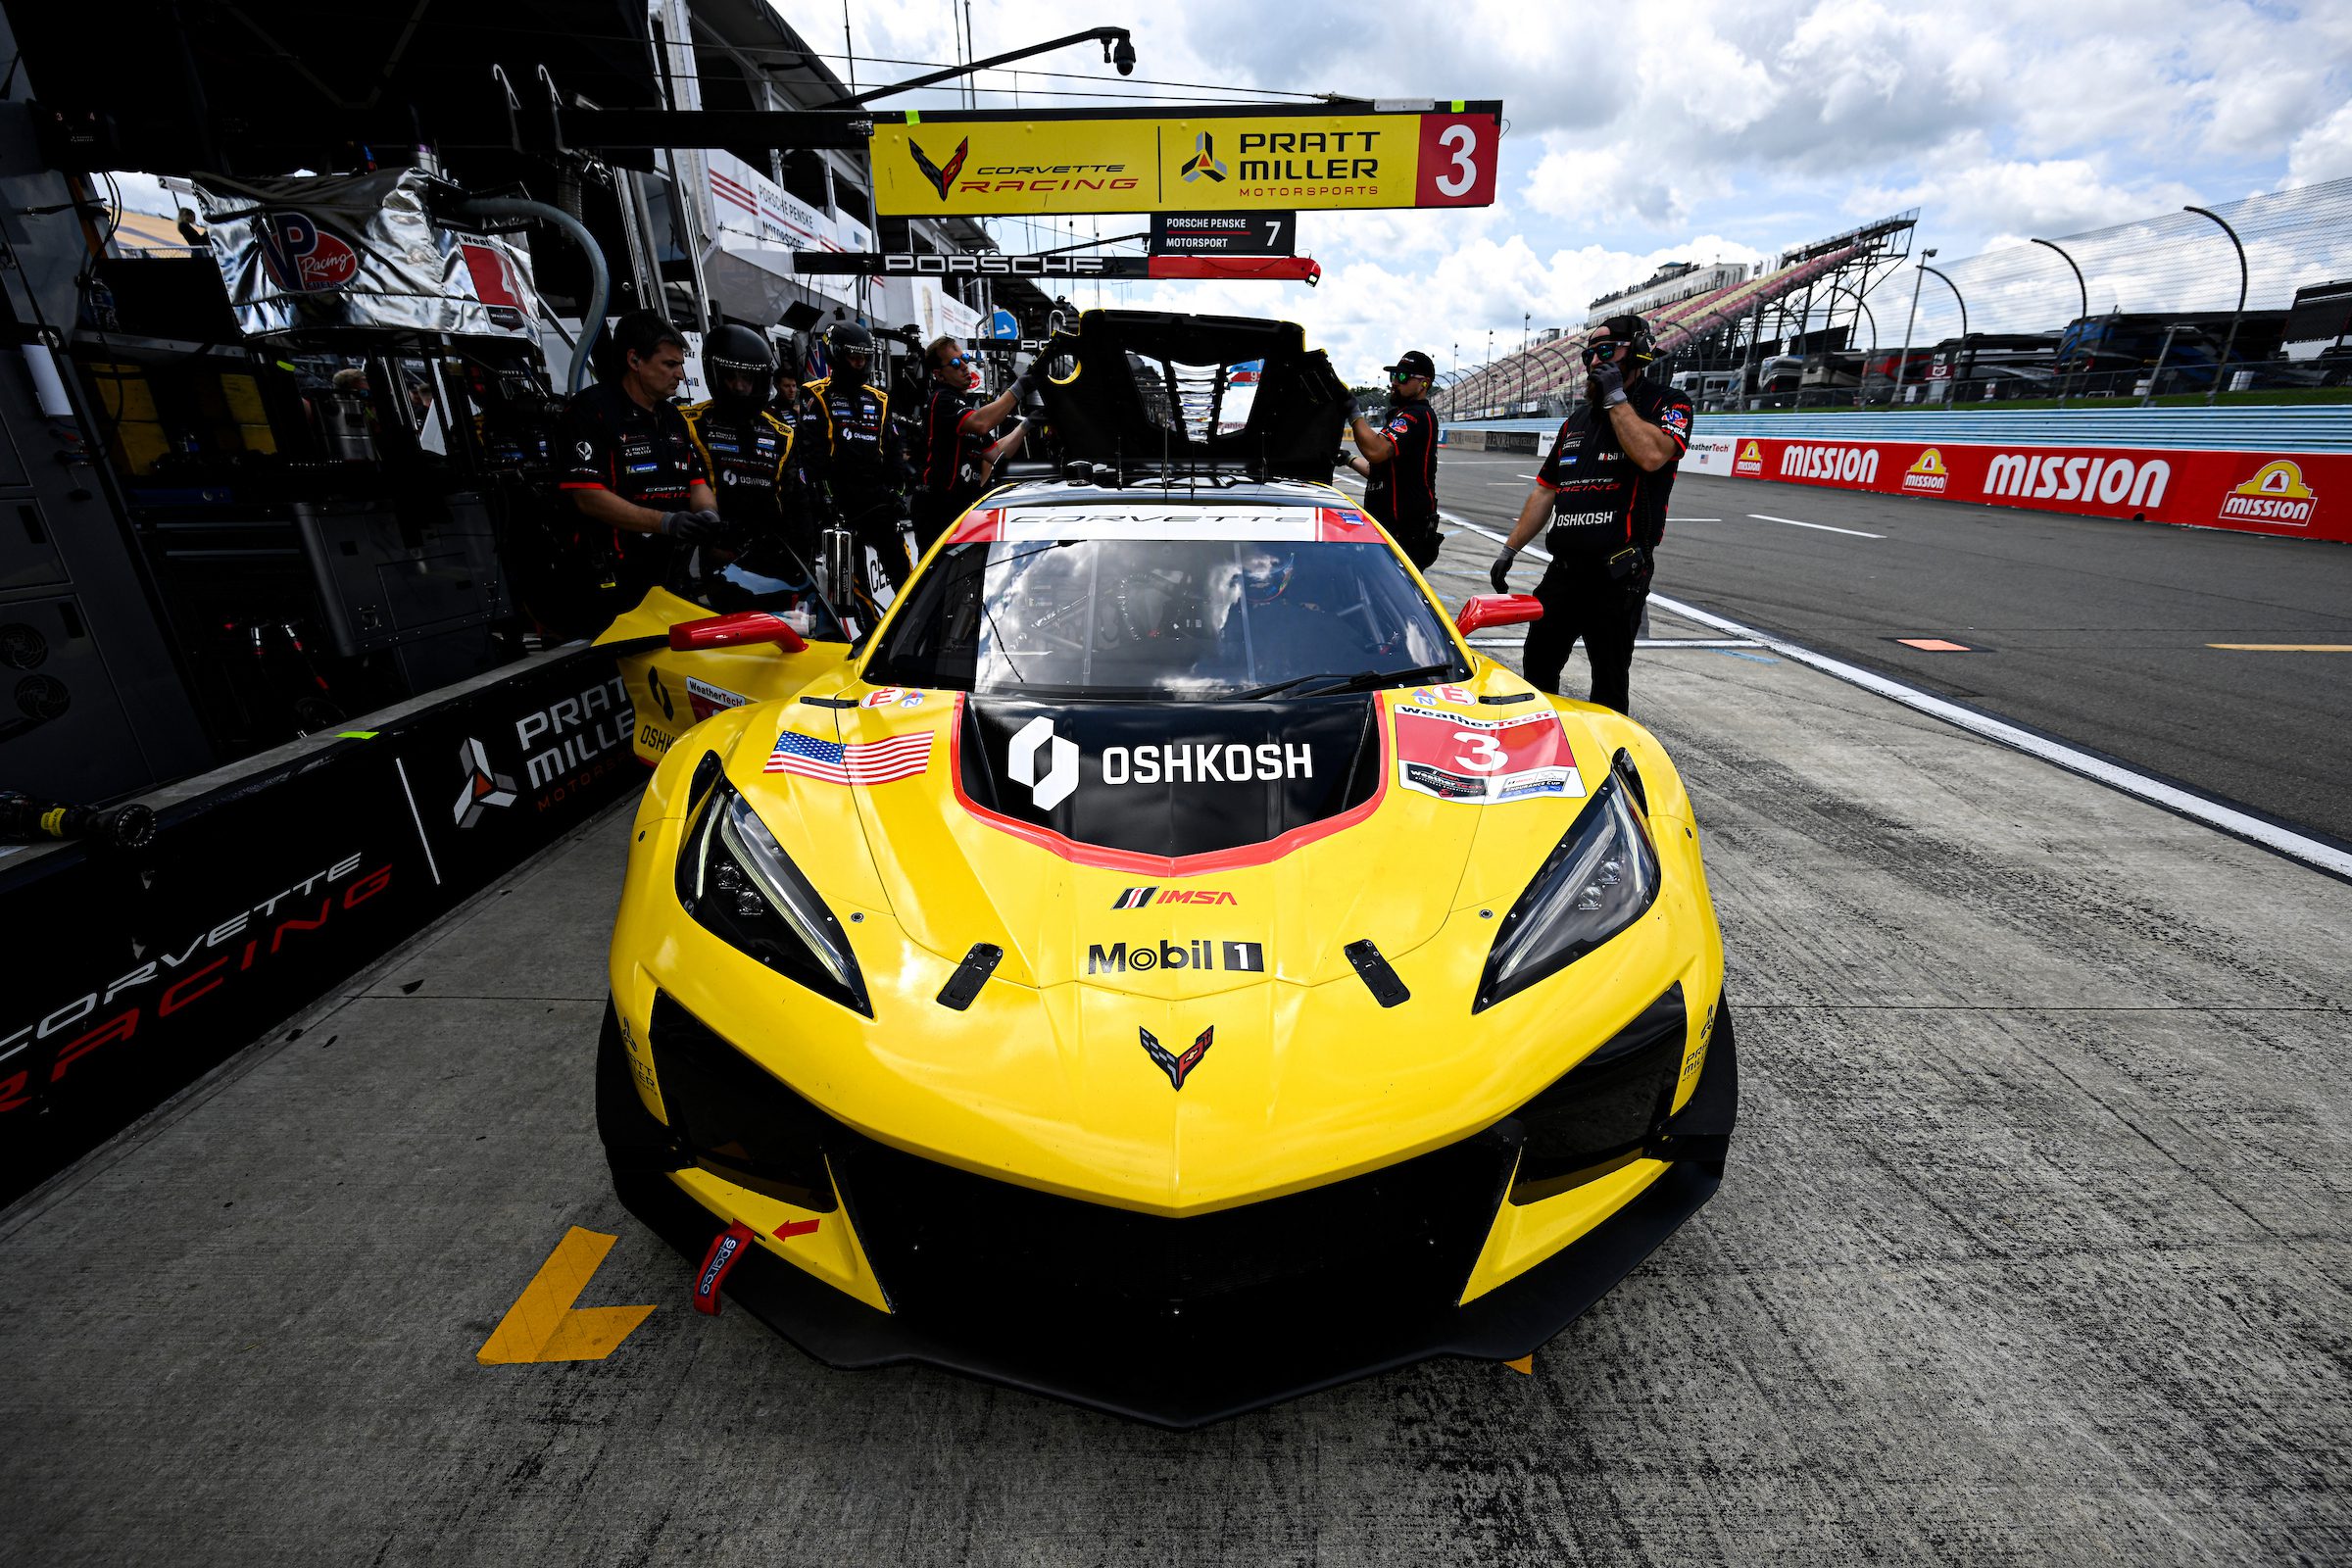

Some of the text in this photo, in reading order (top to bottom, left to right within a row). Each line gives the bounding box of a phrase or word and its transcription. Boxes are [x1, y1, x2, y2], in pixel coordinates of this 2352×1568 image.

[1240, 131, 1381, 154] PRATT
[976, 164, 1126, 175] CORVETTE
[1240, 158, 1379, 181] MILLER
[1435, 123, 1478, 197] 3
[959, 177, 1140, 194] RACING
[1239, 185, 1379, 197] MOTORSPORTS
[1166, 219, 1247, 228] PORSCHE PENSKE
[1265, 221, 1282, 247] 7
[1165, 238, 1228, 248] MOTORSPORT
[301, 253, 355, 281] Racing
[885, 255, 1103, 274] PORSCHE
[1737, 460, 1761, 473] MISSION
[1780, 445, 1880, 483] MISSION
[1560, 477, 1614, 486] CORVETTE
[1904, 473, 1945, 490] MISSION
[1983, 454, 2172, 508] MISSION
[1009, 514, 1311, 524] CORVETTE
[1556, 511, 1614, 527] OSHKOSH
[2224, 496, 2310, 521] MISSION
[689, 680, 743, 707] WeatherTech
[515, 676, 628, 751] PRAT
[1400, 706, 1551, 728] WeatherTech
[526, 708, 635, 790] MILLE
[640, 724, 677, 754] OSHK
[1453, 731, 1509, 772] 3
[1102, 744, 1313, 785] OSHKOSH
[1155, 890, 1238, 906] IMSA
[1088, 940, 1213, 975] Mobil
[699, 1237, 737, 1295] sparco
